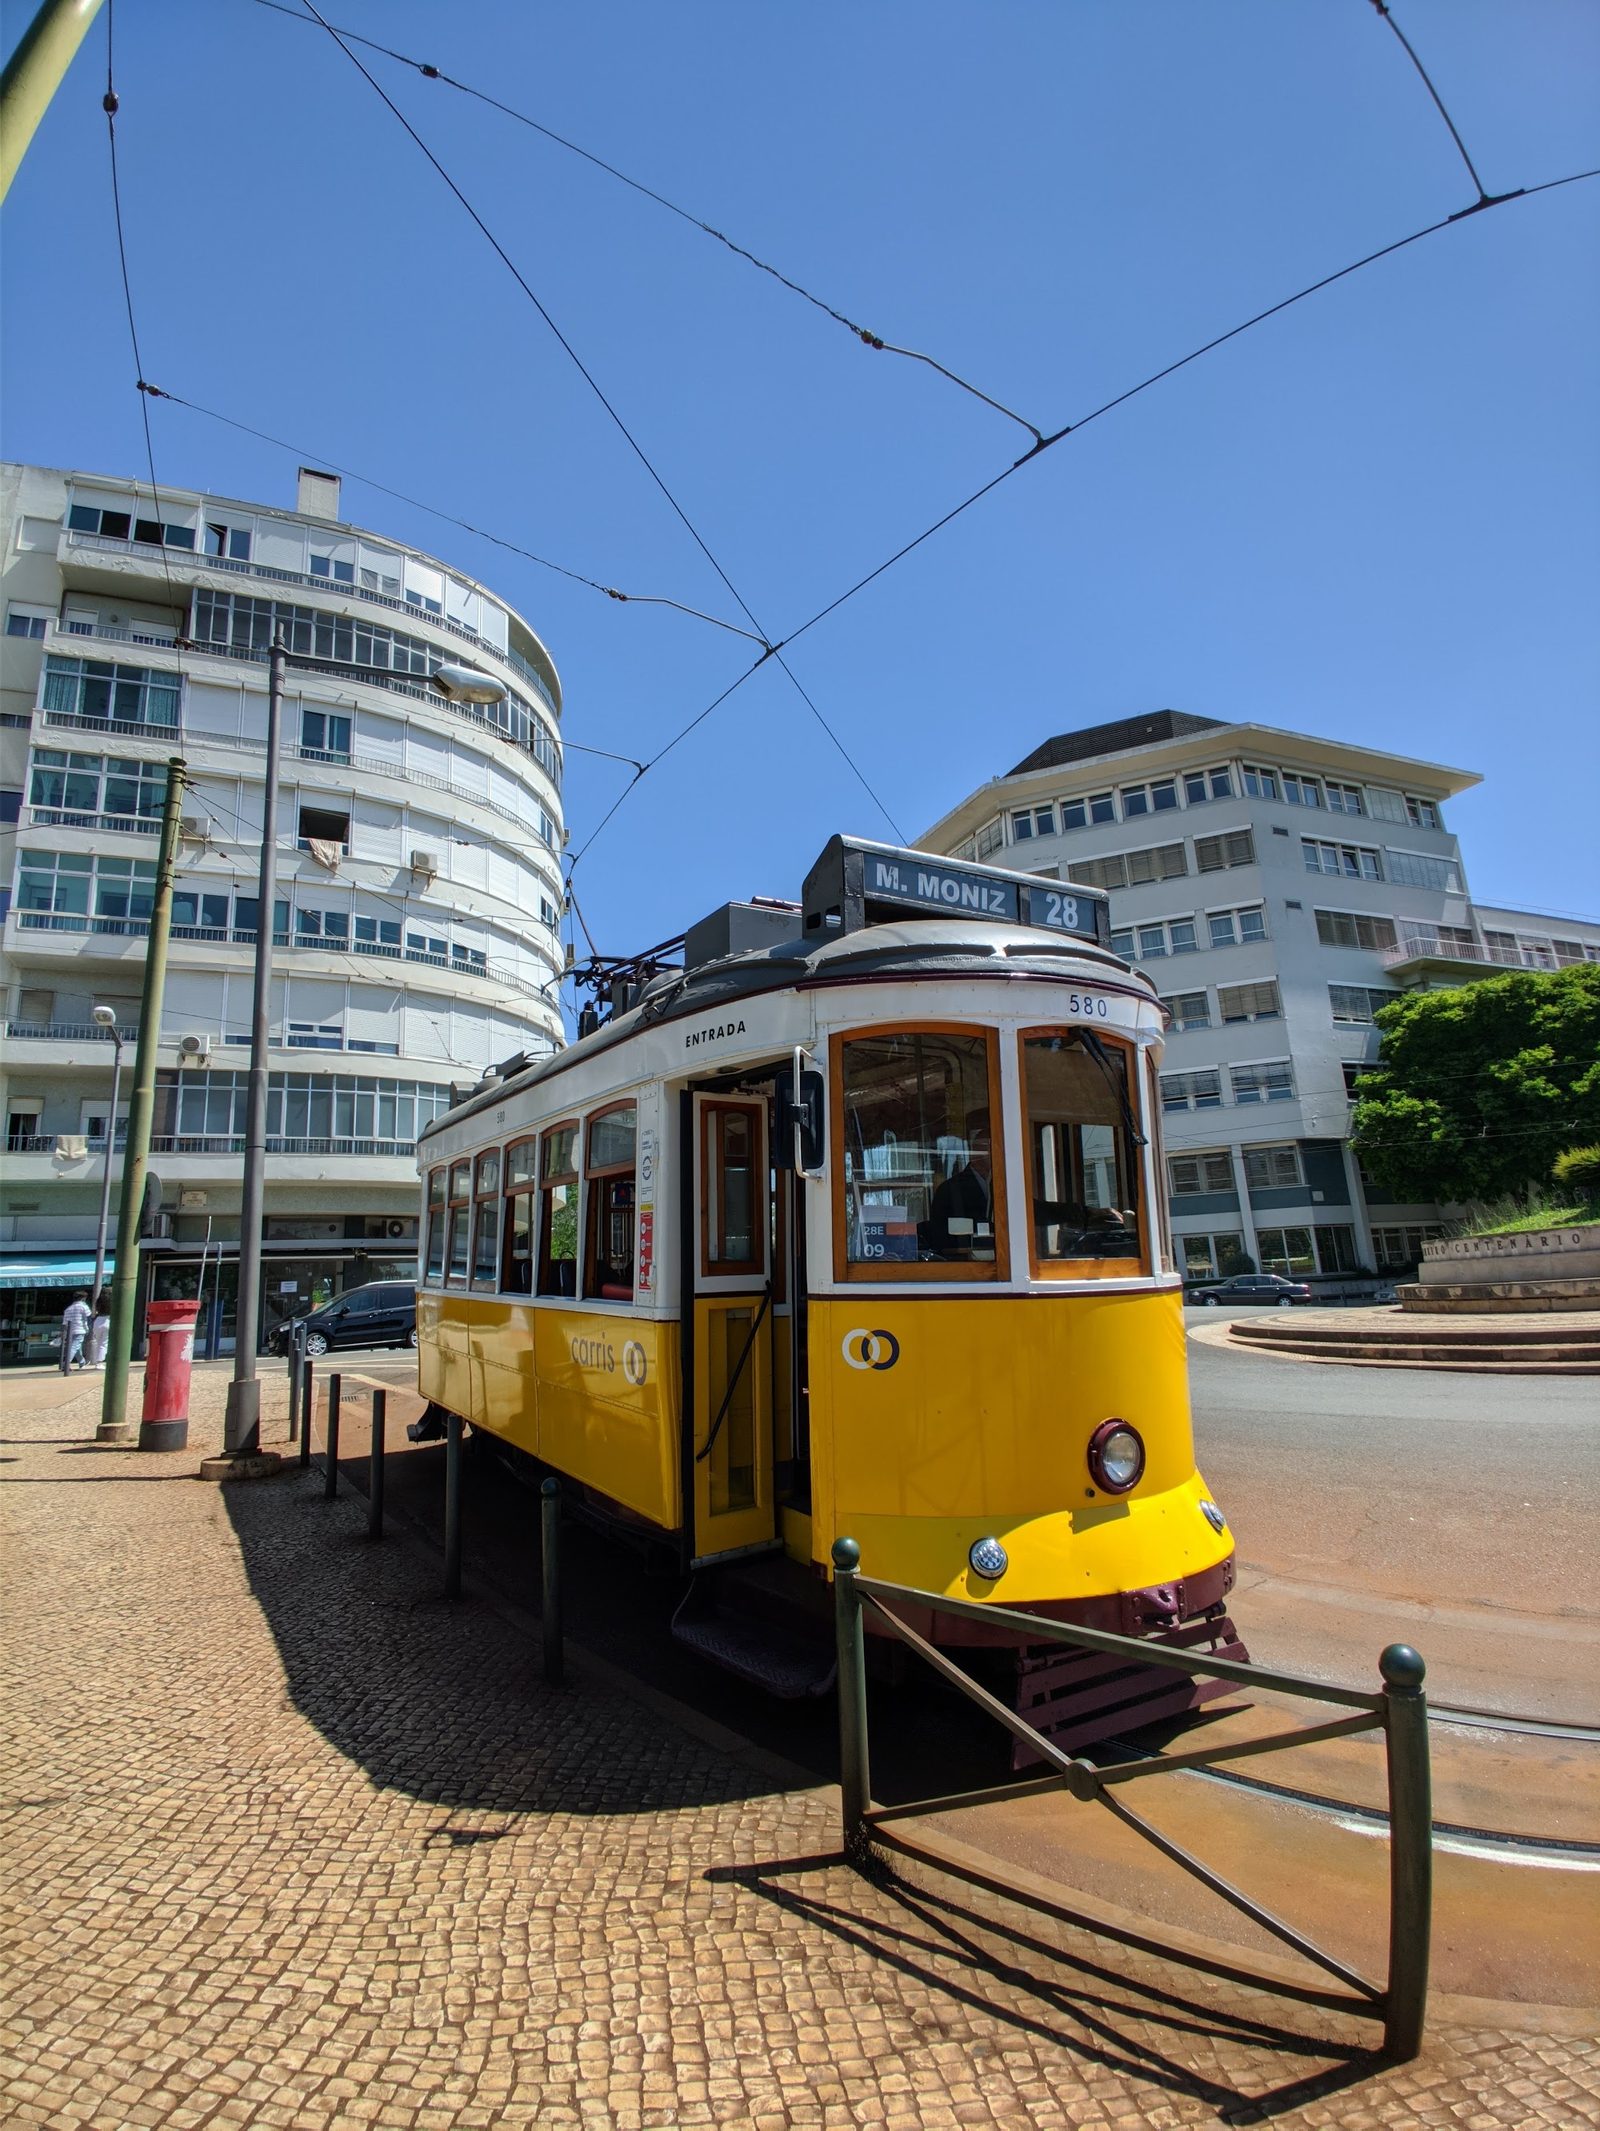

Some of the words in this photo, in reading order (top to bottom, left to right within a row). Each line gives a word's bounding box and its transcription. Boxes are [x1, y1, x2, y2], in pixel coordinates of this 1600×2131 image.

[876, 863, 907, 892] M.
[917, 872, 1006, 914] MONIZ
[1046, 892, 1078, 929] 28
[1070, 994, 1107, 1017] 580
[685, 1020, 746, 1048] ENTRADA
[864, 1226, 885, 1235] 28E
[864, 1243, 885, 1257] 09
[571, 1331, 615, 1373] carris
